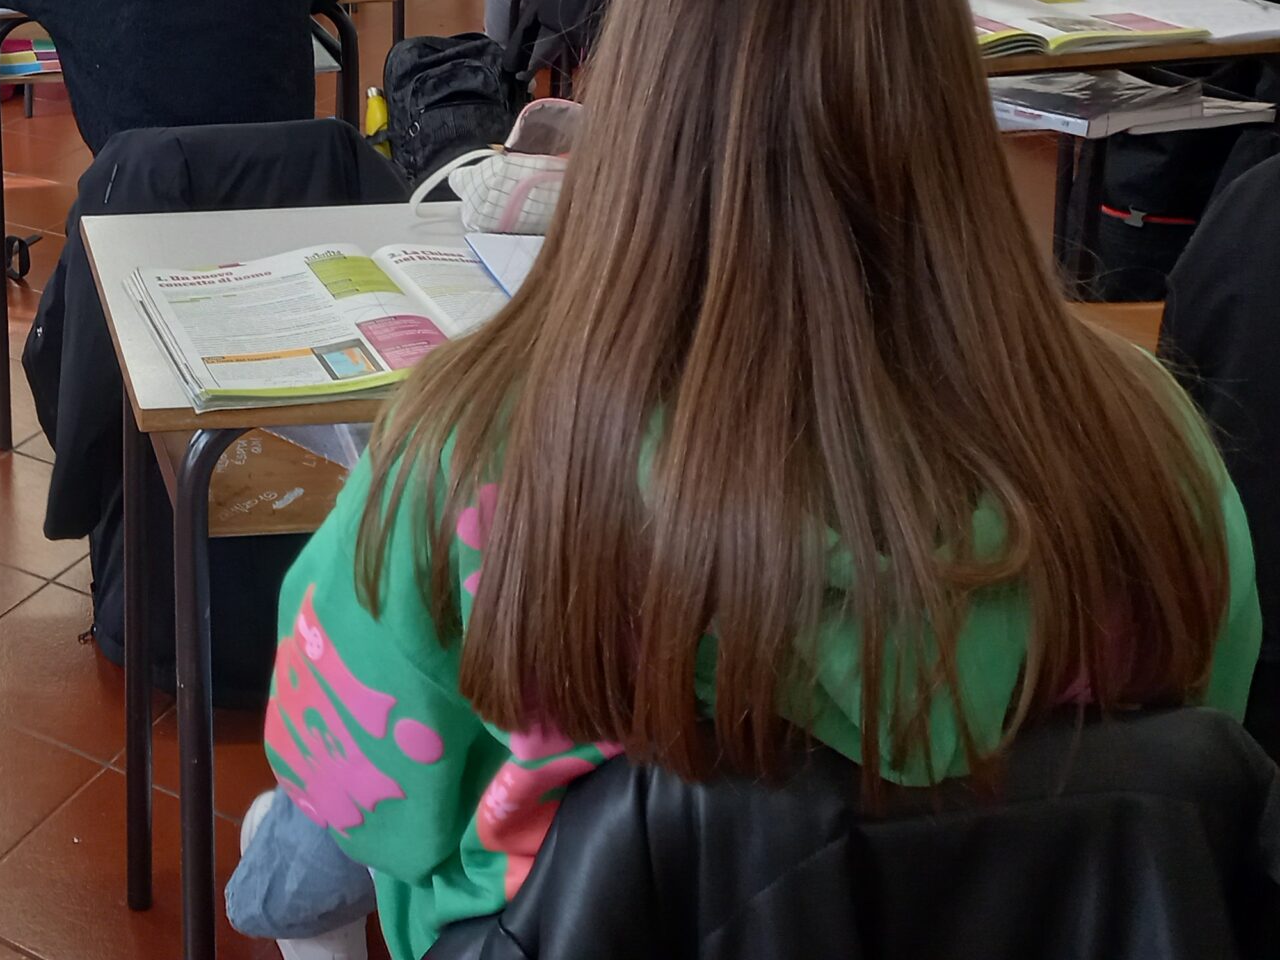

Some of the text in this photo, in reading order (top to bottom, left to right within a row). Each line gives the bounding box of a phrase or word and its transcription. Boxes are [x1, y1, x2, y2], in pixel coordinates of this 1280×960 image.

[419, 249, 465, 258] Chiesa
[158, 280, 216, 288] concetto
[234, 271, 272, 281] uomo
[191, 271, 234, 280] nuovo
